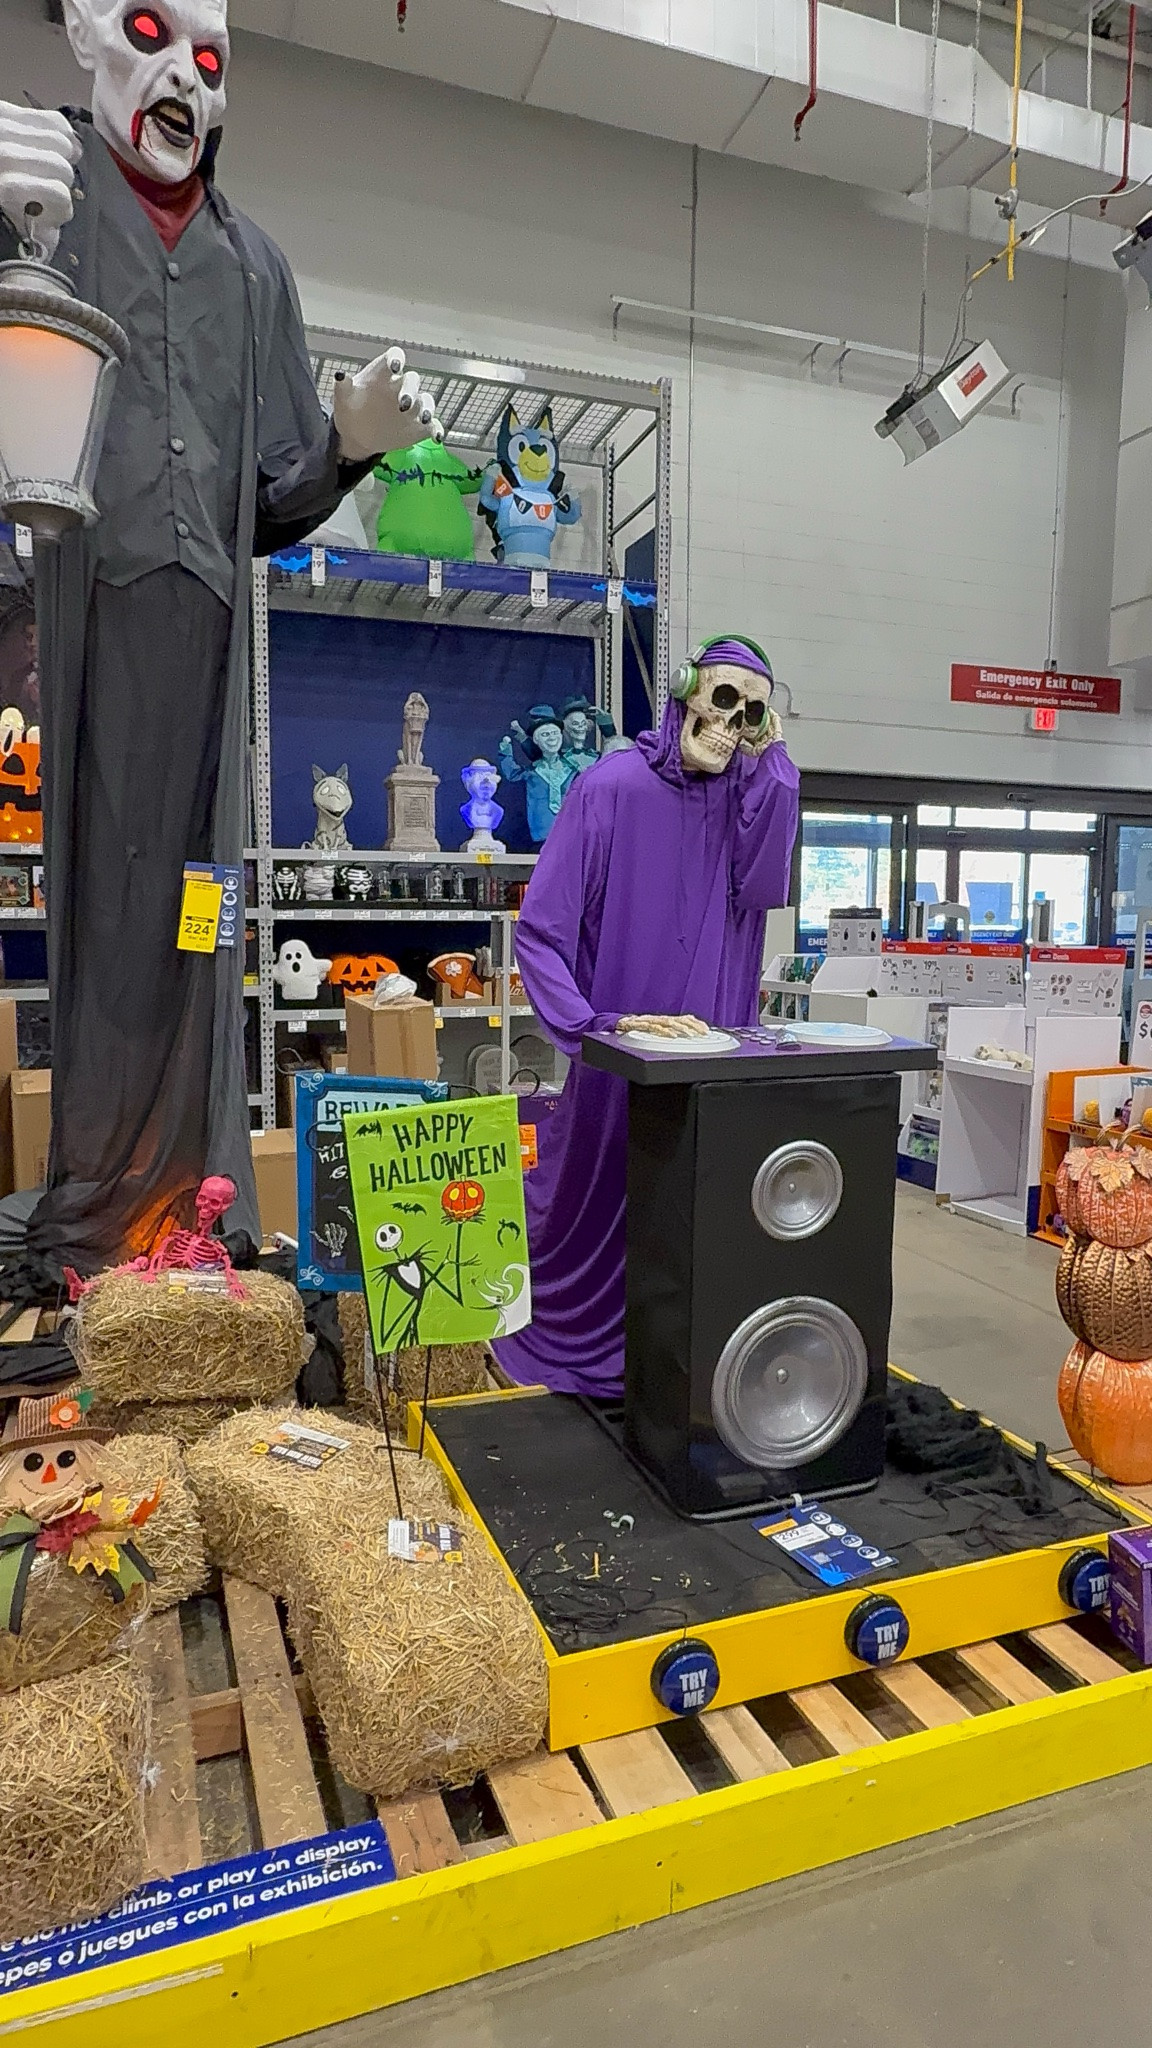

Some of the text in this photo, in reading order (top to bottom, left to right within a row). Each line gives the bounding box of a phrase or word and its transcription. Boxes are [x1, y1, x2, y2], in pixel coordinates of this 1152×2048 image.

[979, 669, 1095, 694] Emergency Exit Only
[975, 689, 1001, 700] Salida
[1003, 692, 1013, 701] de
[184, 922, 210, 936] 224
[392, 1113, 474, 1153] HAPPY
[369, 1142, 507, 1193] HALLOWEEN
[874, 1621, 900, 1645] TRY
[877, 1642, 898, 1660] ME
[679, 1668, 708, 1692] TRY
[683, 1689, 705, 1708] ME
[107, 1888, 172, 1920] climb
[178, 1882, 202, 1899] or
[208, 1866, 257, 1894] play
[262, 1858, 290, 1875] on
[295, 1835, 377, 1867] display.
[78, 1917, 178, 1965] juegues
[184, 1902, 227, 1925] con
[233, 1894, 255, 1910] la
[260, 1860, 383, 1901] exhibición.
